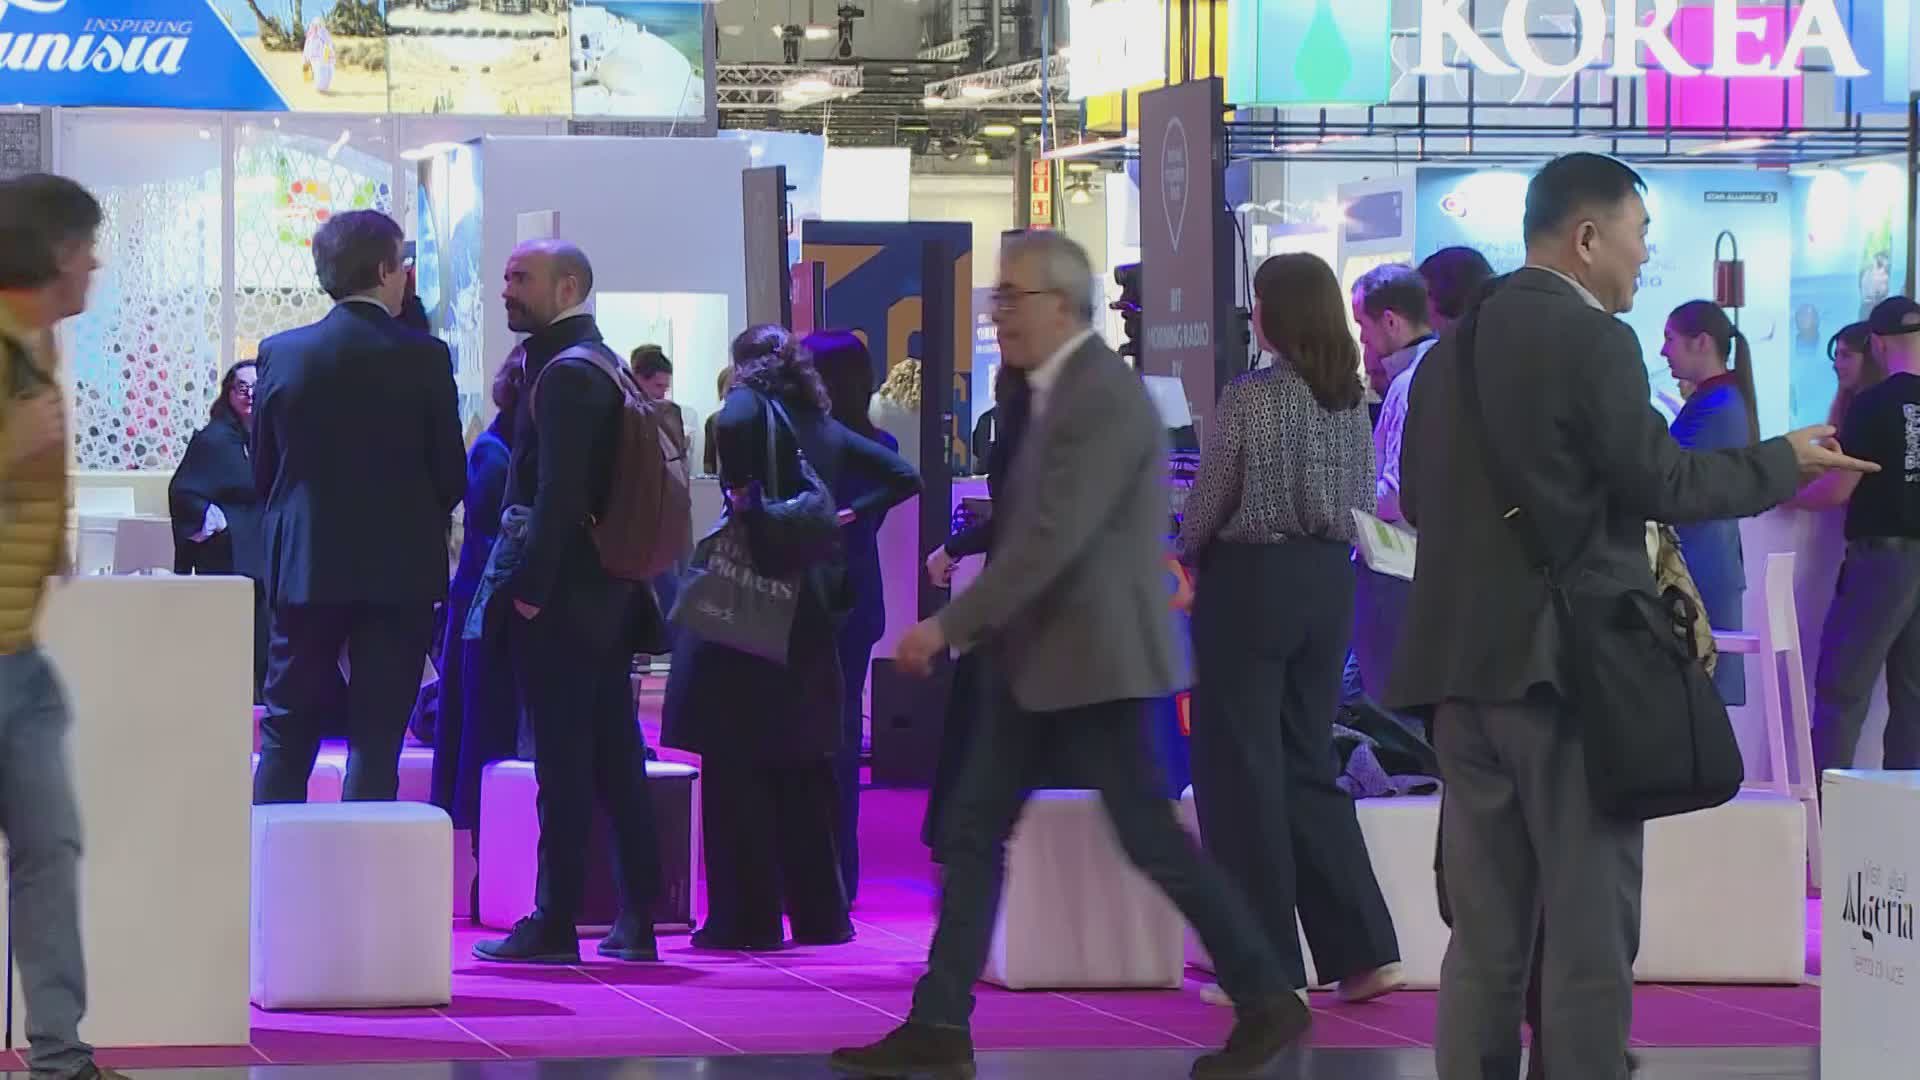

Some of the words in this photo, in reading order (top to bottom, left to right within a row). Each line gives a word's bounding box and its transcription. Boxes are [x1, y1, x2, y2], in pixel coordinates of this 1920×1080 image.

[84, 17, 193, 34] INSPIRING
[1409, 0, 1871, 78] KOREA
[0, 31, 190, 75] unisia
[1183, 321, 1209, 348] RADIO
[1842, 871, 1914, 946] Algeria
